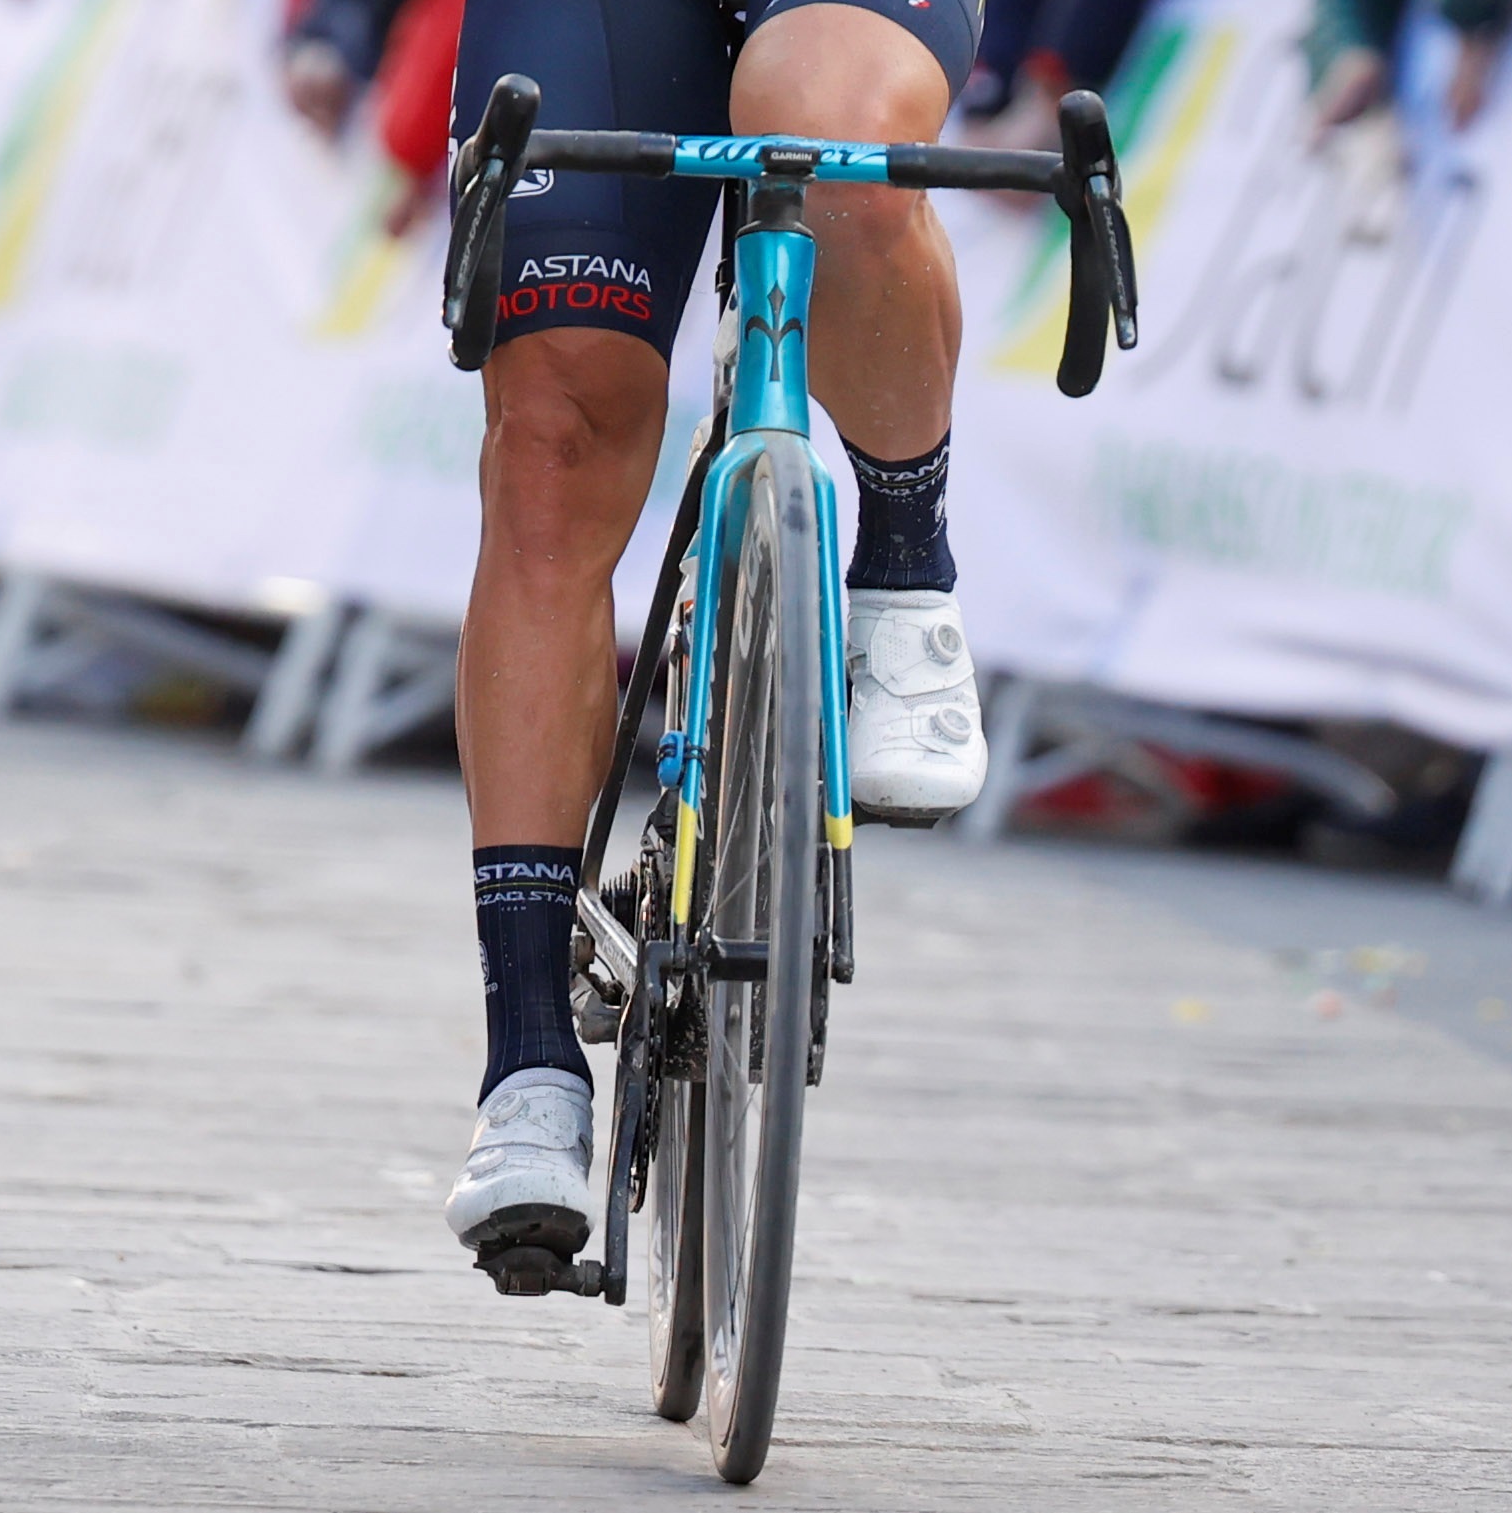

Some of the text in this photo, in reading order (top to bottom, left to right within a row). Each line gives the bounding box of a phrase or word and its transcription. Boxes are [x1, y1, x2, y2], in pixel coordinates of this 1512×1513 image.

[770, 150, 813, 162] GARMIN
[518, 254, 652, 292] ASTANA
[476, 890, 573, 907] AZAQSTAN
